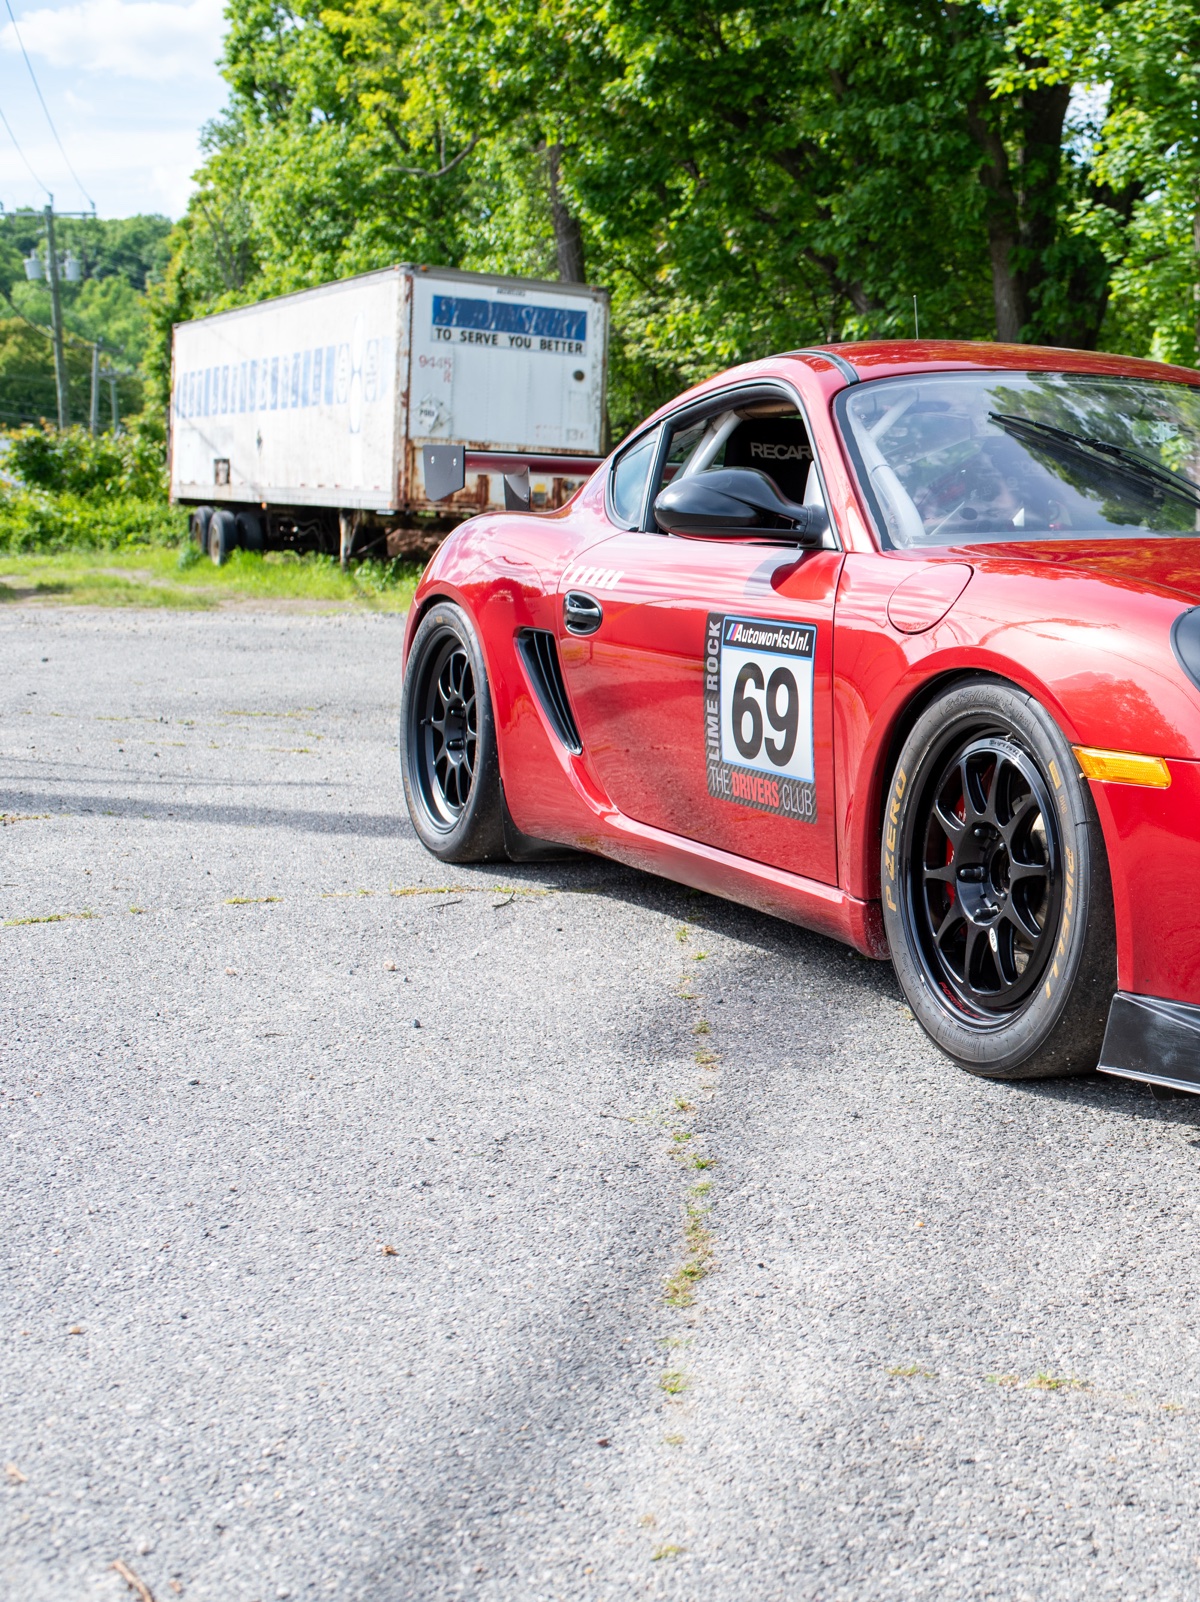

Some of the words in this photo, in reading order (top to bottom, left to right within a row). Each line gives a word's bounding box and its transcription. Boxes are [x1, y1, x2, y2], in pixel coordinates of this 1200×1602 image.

[435, 327, 452, 341] TO
[460, 330, 499, 346] SERVE
[508, 335, 532, 349] YOU
[539, 339, 583, 355] BETTER
[750, 441, 813, 460] RECAR
[706, 620, 723, 692] ROCK
[735, 623, 810, 653] AutoworksUnl.
[706, 699, 721, 763] LIME
[731, 661, 800, 768] 69
[709, 764, 731, 795] THE
[731, 771, 780, 808] DRIVERS
[782, 783, 814, 816] CLUB
[885, 767, 907, 881] ZERO
[1045, 845, 1075, 999] PIRELLI
